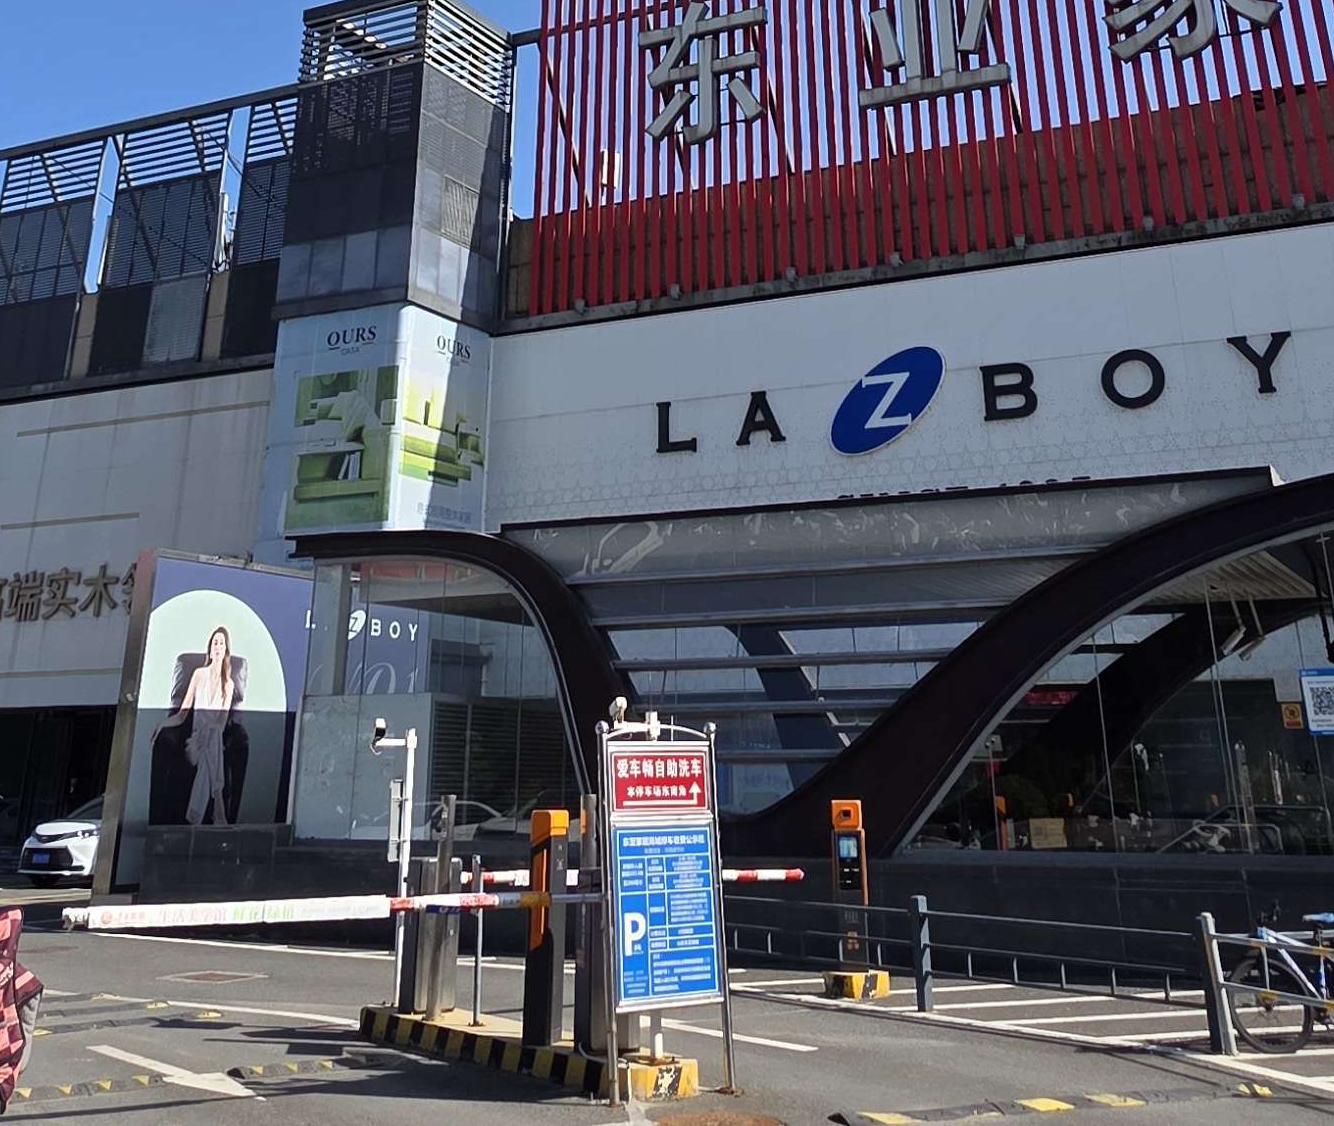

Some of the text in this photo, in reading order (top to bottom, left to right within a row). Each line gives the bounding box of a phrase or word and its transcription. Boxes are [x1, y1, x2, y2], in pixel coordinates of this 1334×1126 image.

[327, 325, 377, 349] OURS
[436, 334, 471, 360] OURS
[617, 758, 702, 779] 爱车畅自助洗车
[626, 785, 687, 798] 本停车场东南角
[624, 912, 646, 957] P
